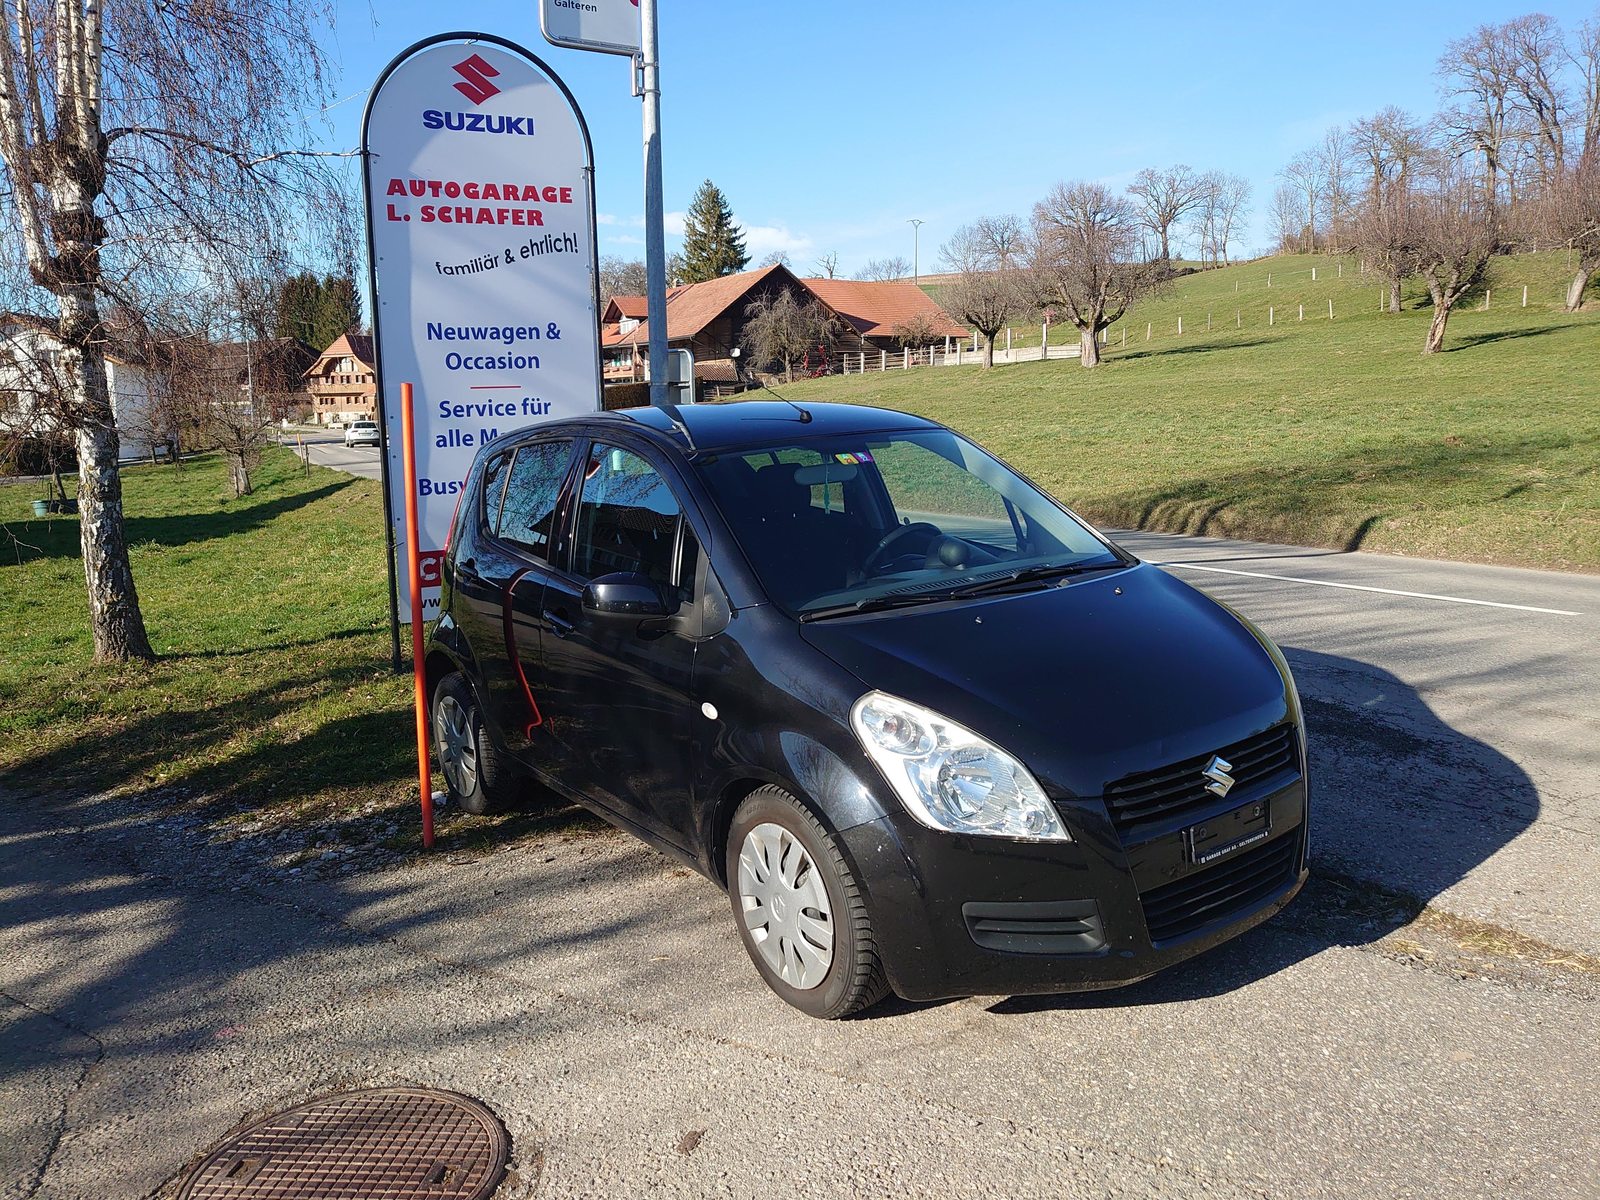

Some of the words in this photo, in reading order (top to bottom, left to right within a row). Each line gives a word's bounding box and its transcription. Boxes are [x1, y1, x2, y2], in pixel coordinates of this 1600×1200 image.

[554, 0, 597, 12] Galteren
[422, 109, 535, 136] SUZUKI
[386, 178, 573, 203] AUTOGARAGE
[386, 204, 411, 222] L.
[420, 205, 545, 226] SCHAFER
[435, 254, 500, 276] familiär
[504, 248, 516, 264] &
[519, 232, 579, 259] ehrlich!
[426, 322, 541, 345] Neuwagen
[546, 322, 561, 340] &
[445, 351, 540, 370] Occasion
[439, 399, 517, 418] Service
[521, 397, 552, 416] für
[435, 428, 474, 448] alle
